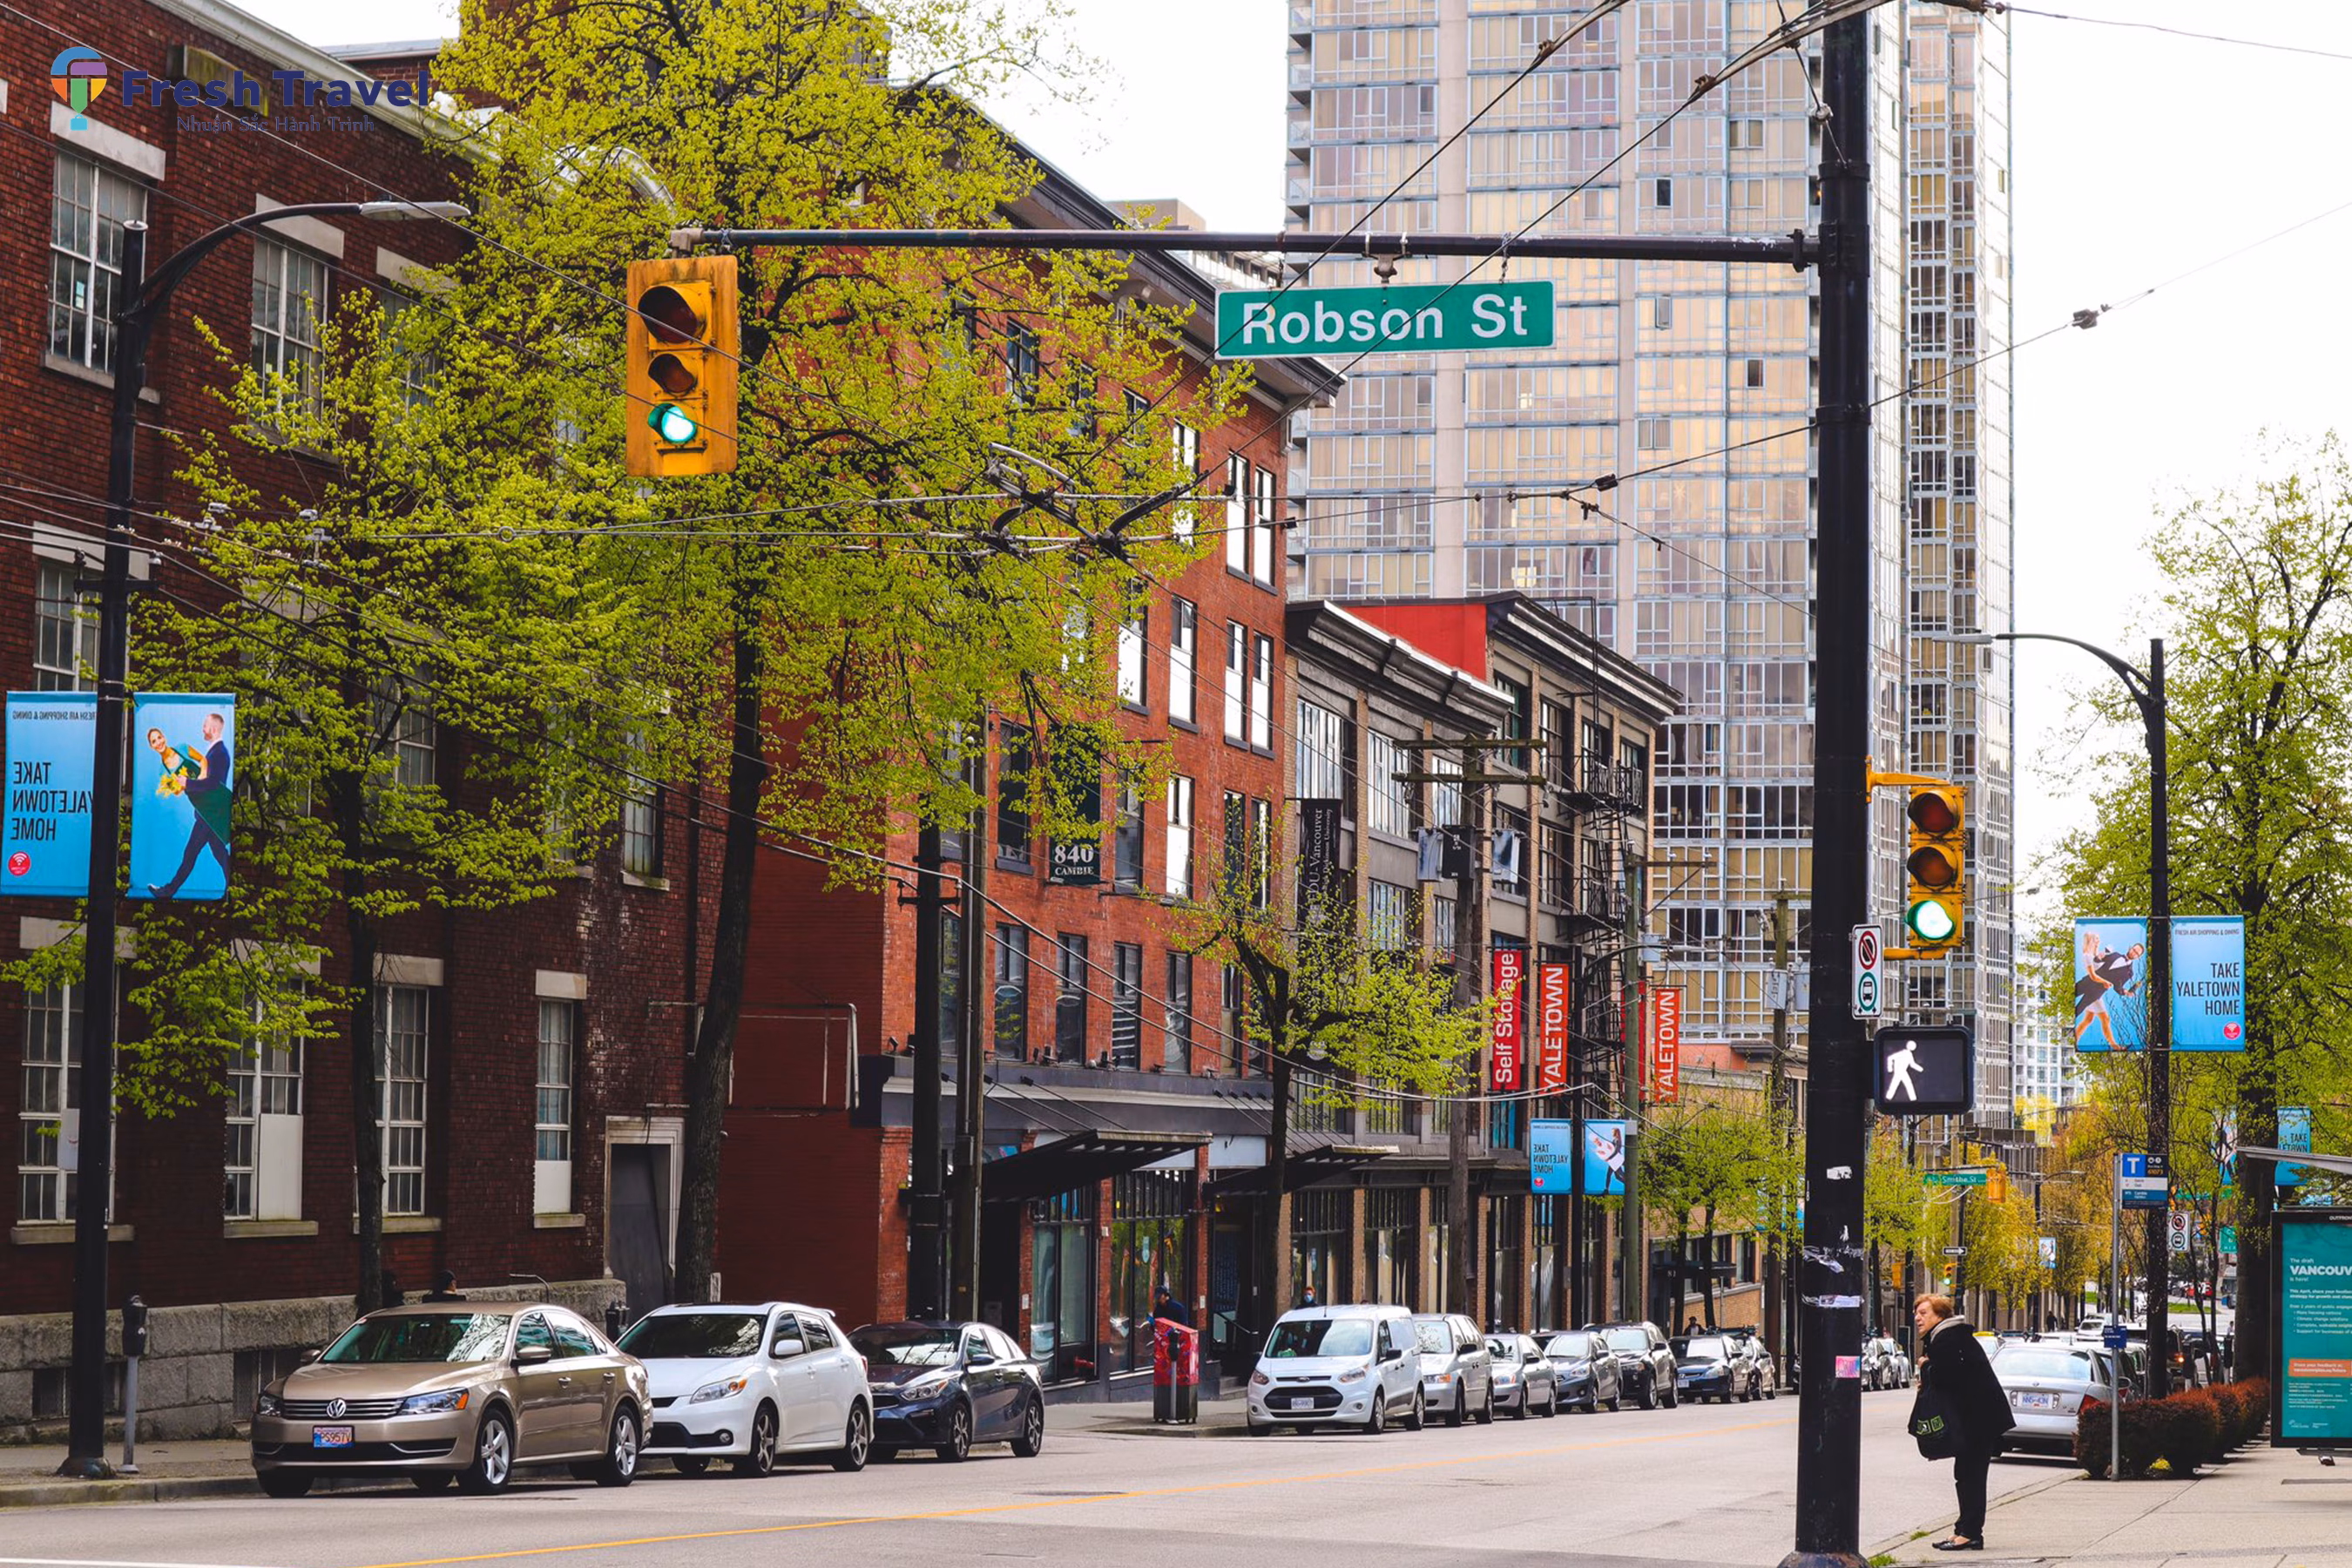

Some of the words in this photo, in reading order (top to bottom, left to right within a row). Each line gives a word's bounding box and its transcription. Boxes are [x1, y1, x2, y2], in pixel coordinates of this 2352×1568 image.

[1241, 301, 1443, 345] Robson
[1470, 294, 1528, 339] St
[1323, 808, 1333, 840] University
[1054, 843, 1094, 865] 840
[1055, 866, 1094, 875] CAMBIE
[2210, 963, 2240, 978] TAKE
[2176, 982, 2240, 997] YALETOWN
[2205, 1000, 2240, 1016] HOME
[1544, 967, 1564, 1094] YALETOWN
[1659, 991, 1675, 1099] YALETOWN
[1496, 1043, 1513, 1083] Self
[2127, 1157, 2139, 1174] T
[2289, 1265, 2352, 1275] VANCOUV
